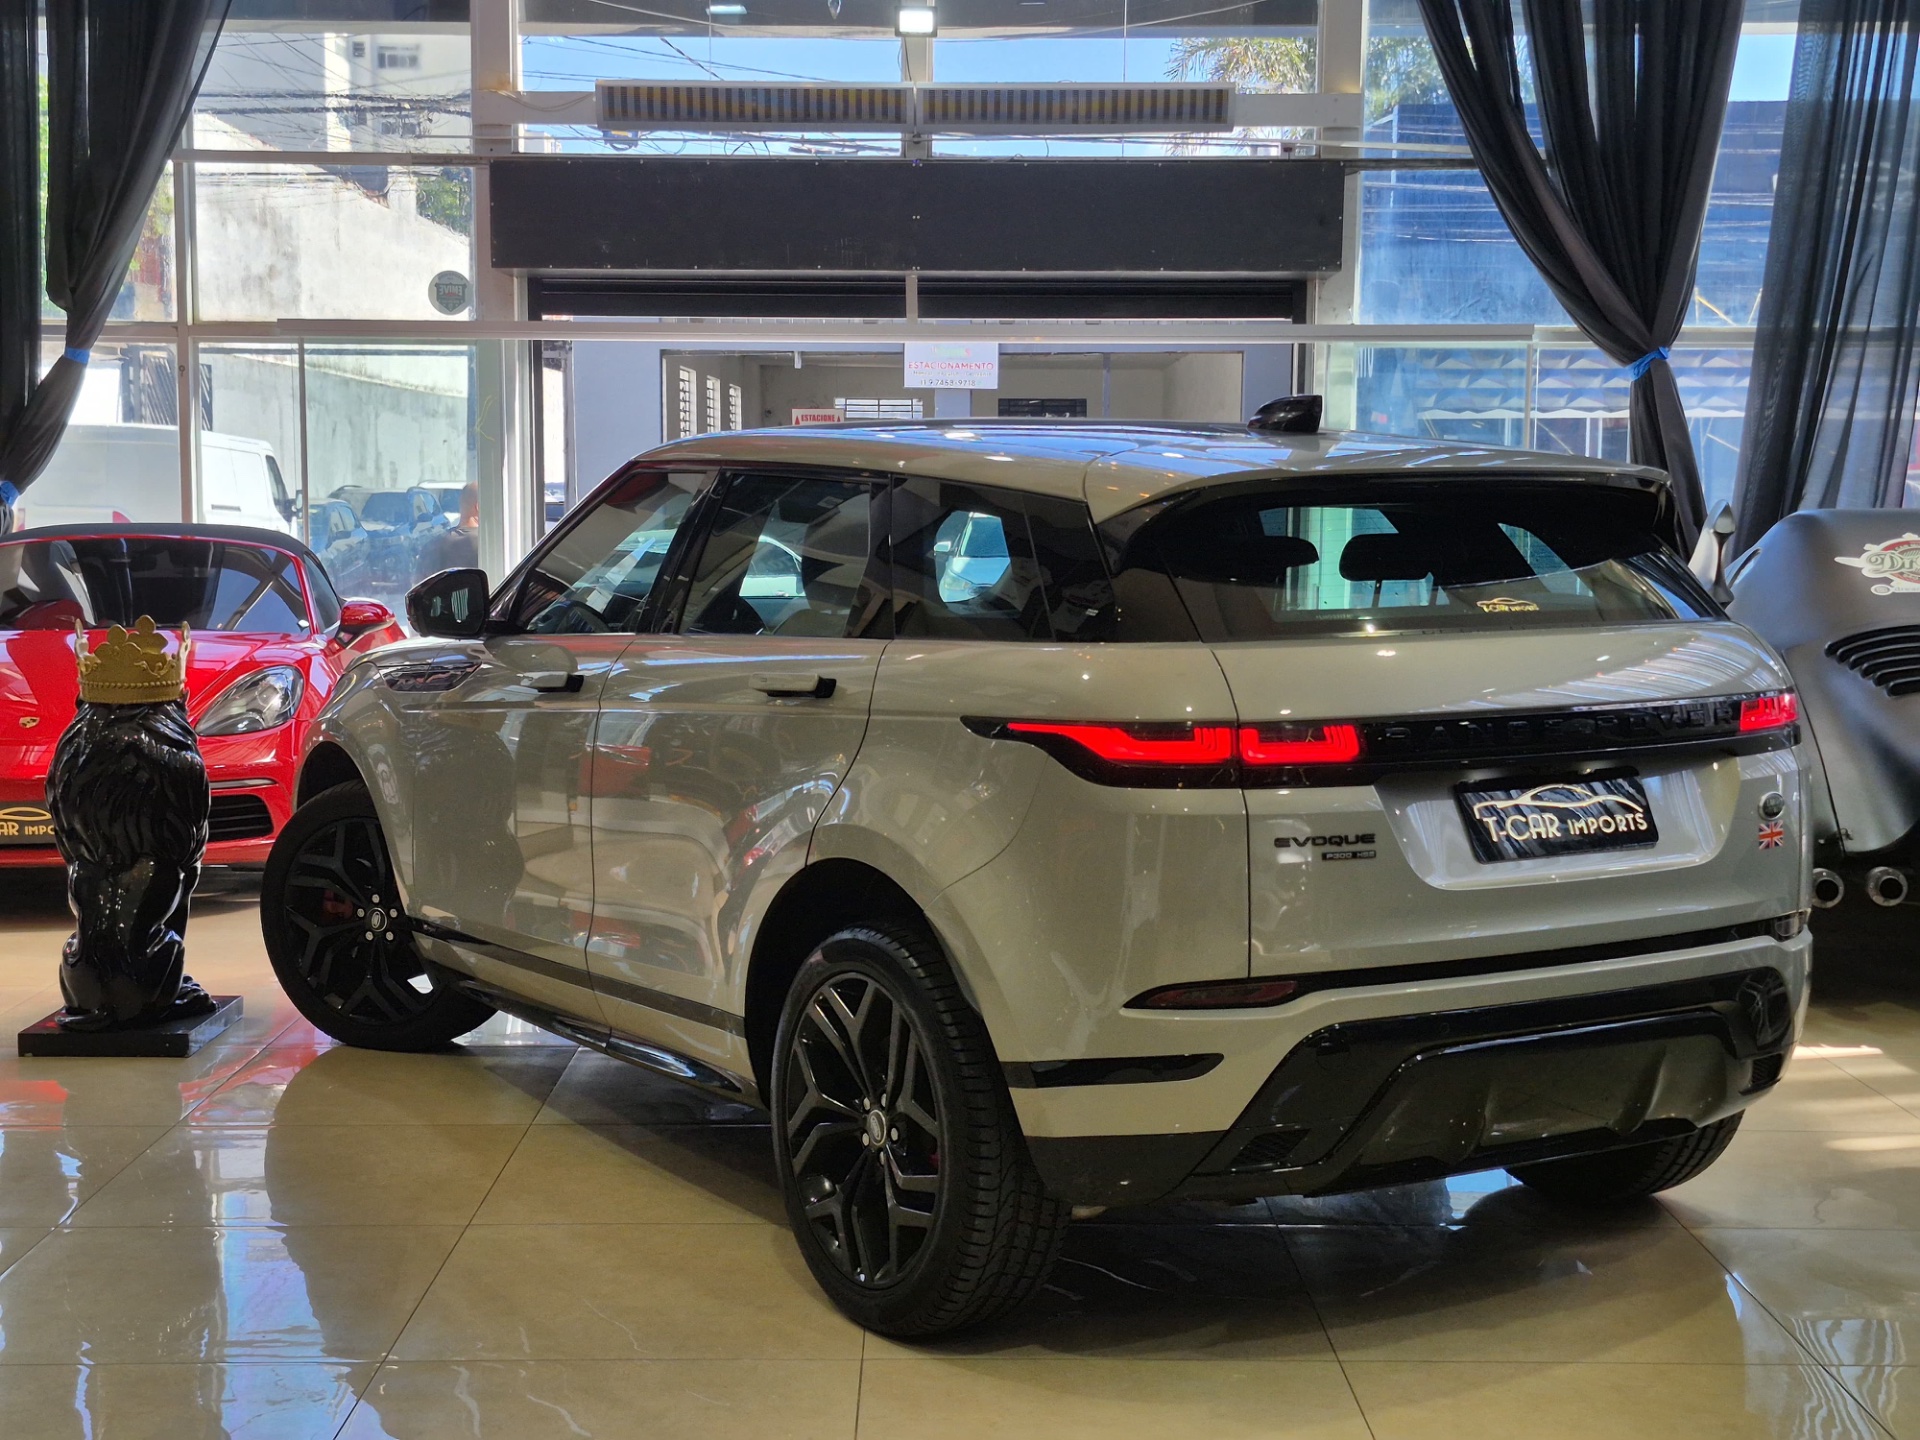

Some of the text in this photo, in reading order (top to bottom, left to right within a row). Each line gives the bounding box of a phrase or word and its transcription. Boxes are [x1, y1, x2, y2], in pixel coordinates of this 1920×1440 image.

[908, 361, 994, 371] ESTACIONAMENTO
[801, 414, 835, 422] ESTACIONE
[1483, 812, 1648, 842] T-CAR IMPORTS
[1274, 833, 1376, 848] EVOQUE
